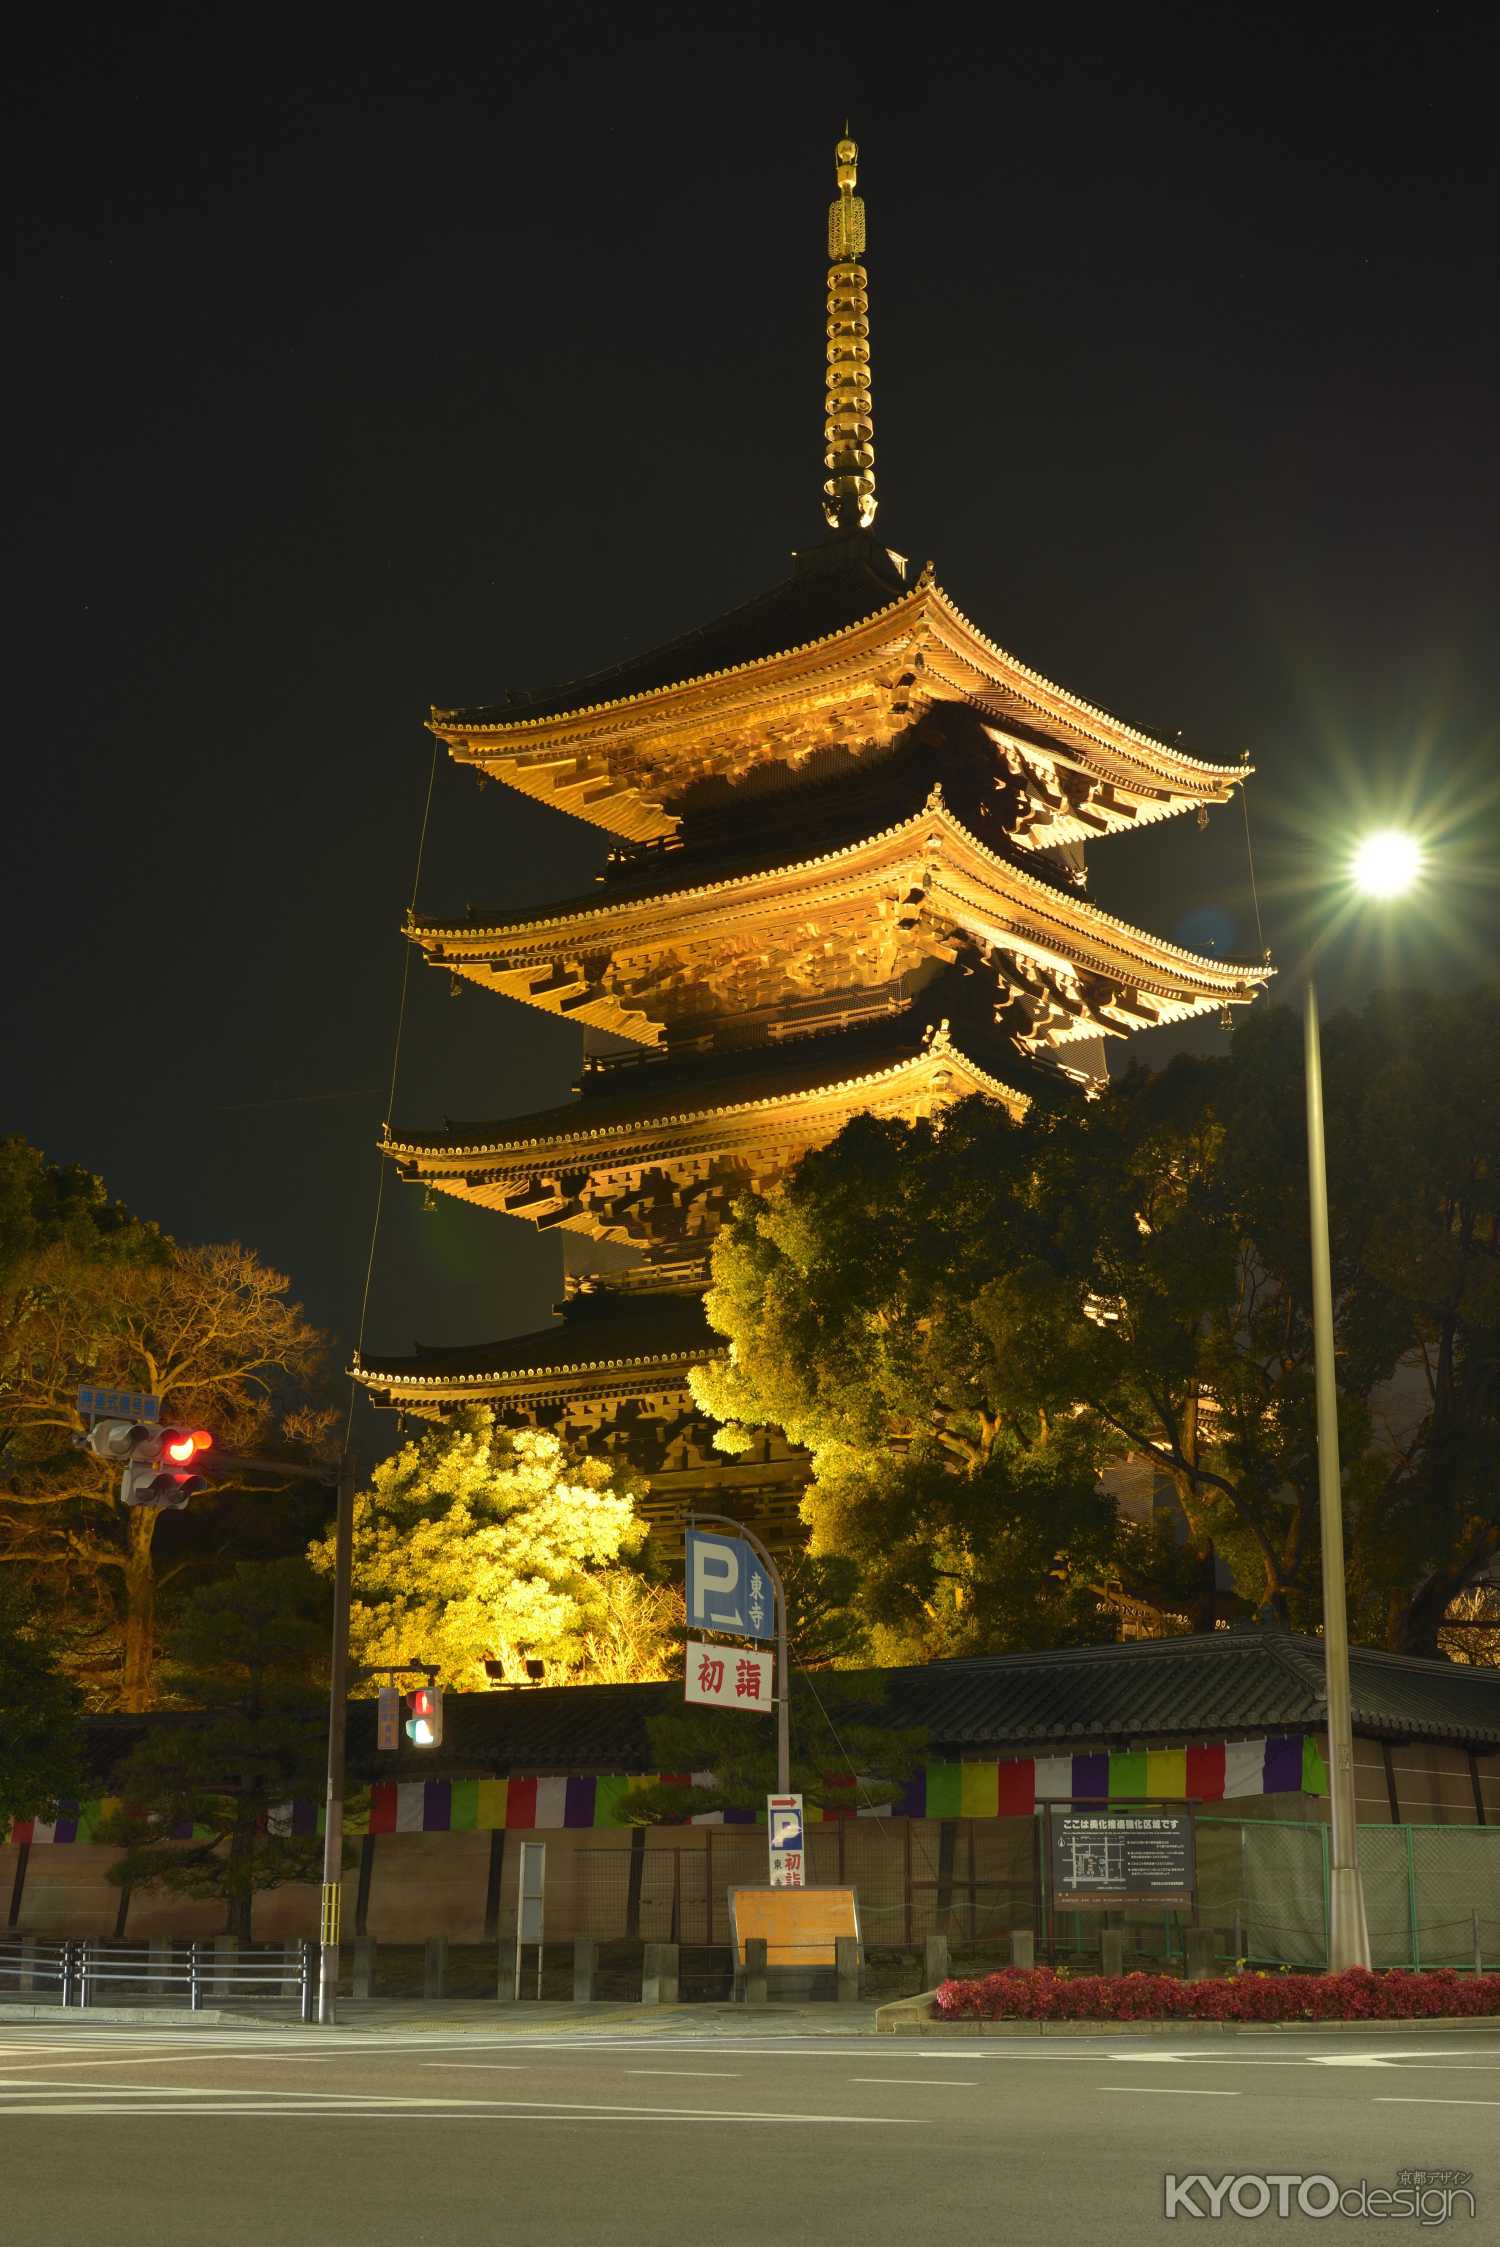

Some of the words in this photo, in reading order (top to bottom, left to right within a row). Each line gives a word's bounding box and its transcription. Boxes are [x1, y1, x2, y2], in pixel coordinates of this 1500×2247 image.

[692, 1540, 739, 1619] P
[748, 1572, 765, 1630] 東寺
[697, 1654, 762, 1700] 初詣
[773, 1812, 799, 1847] P
